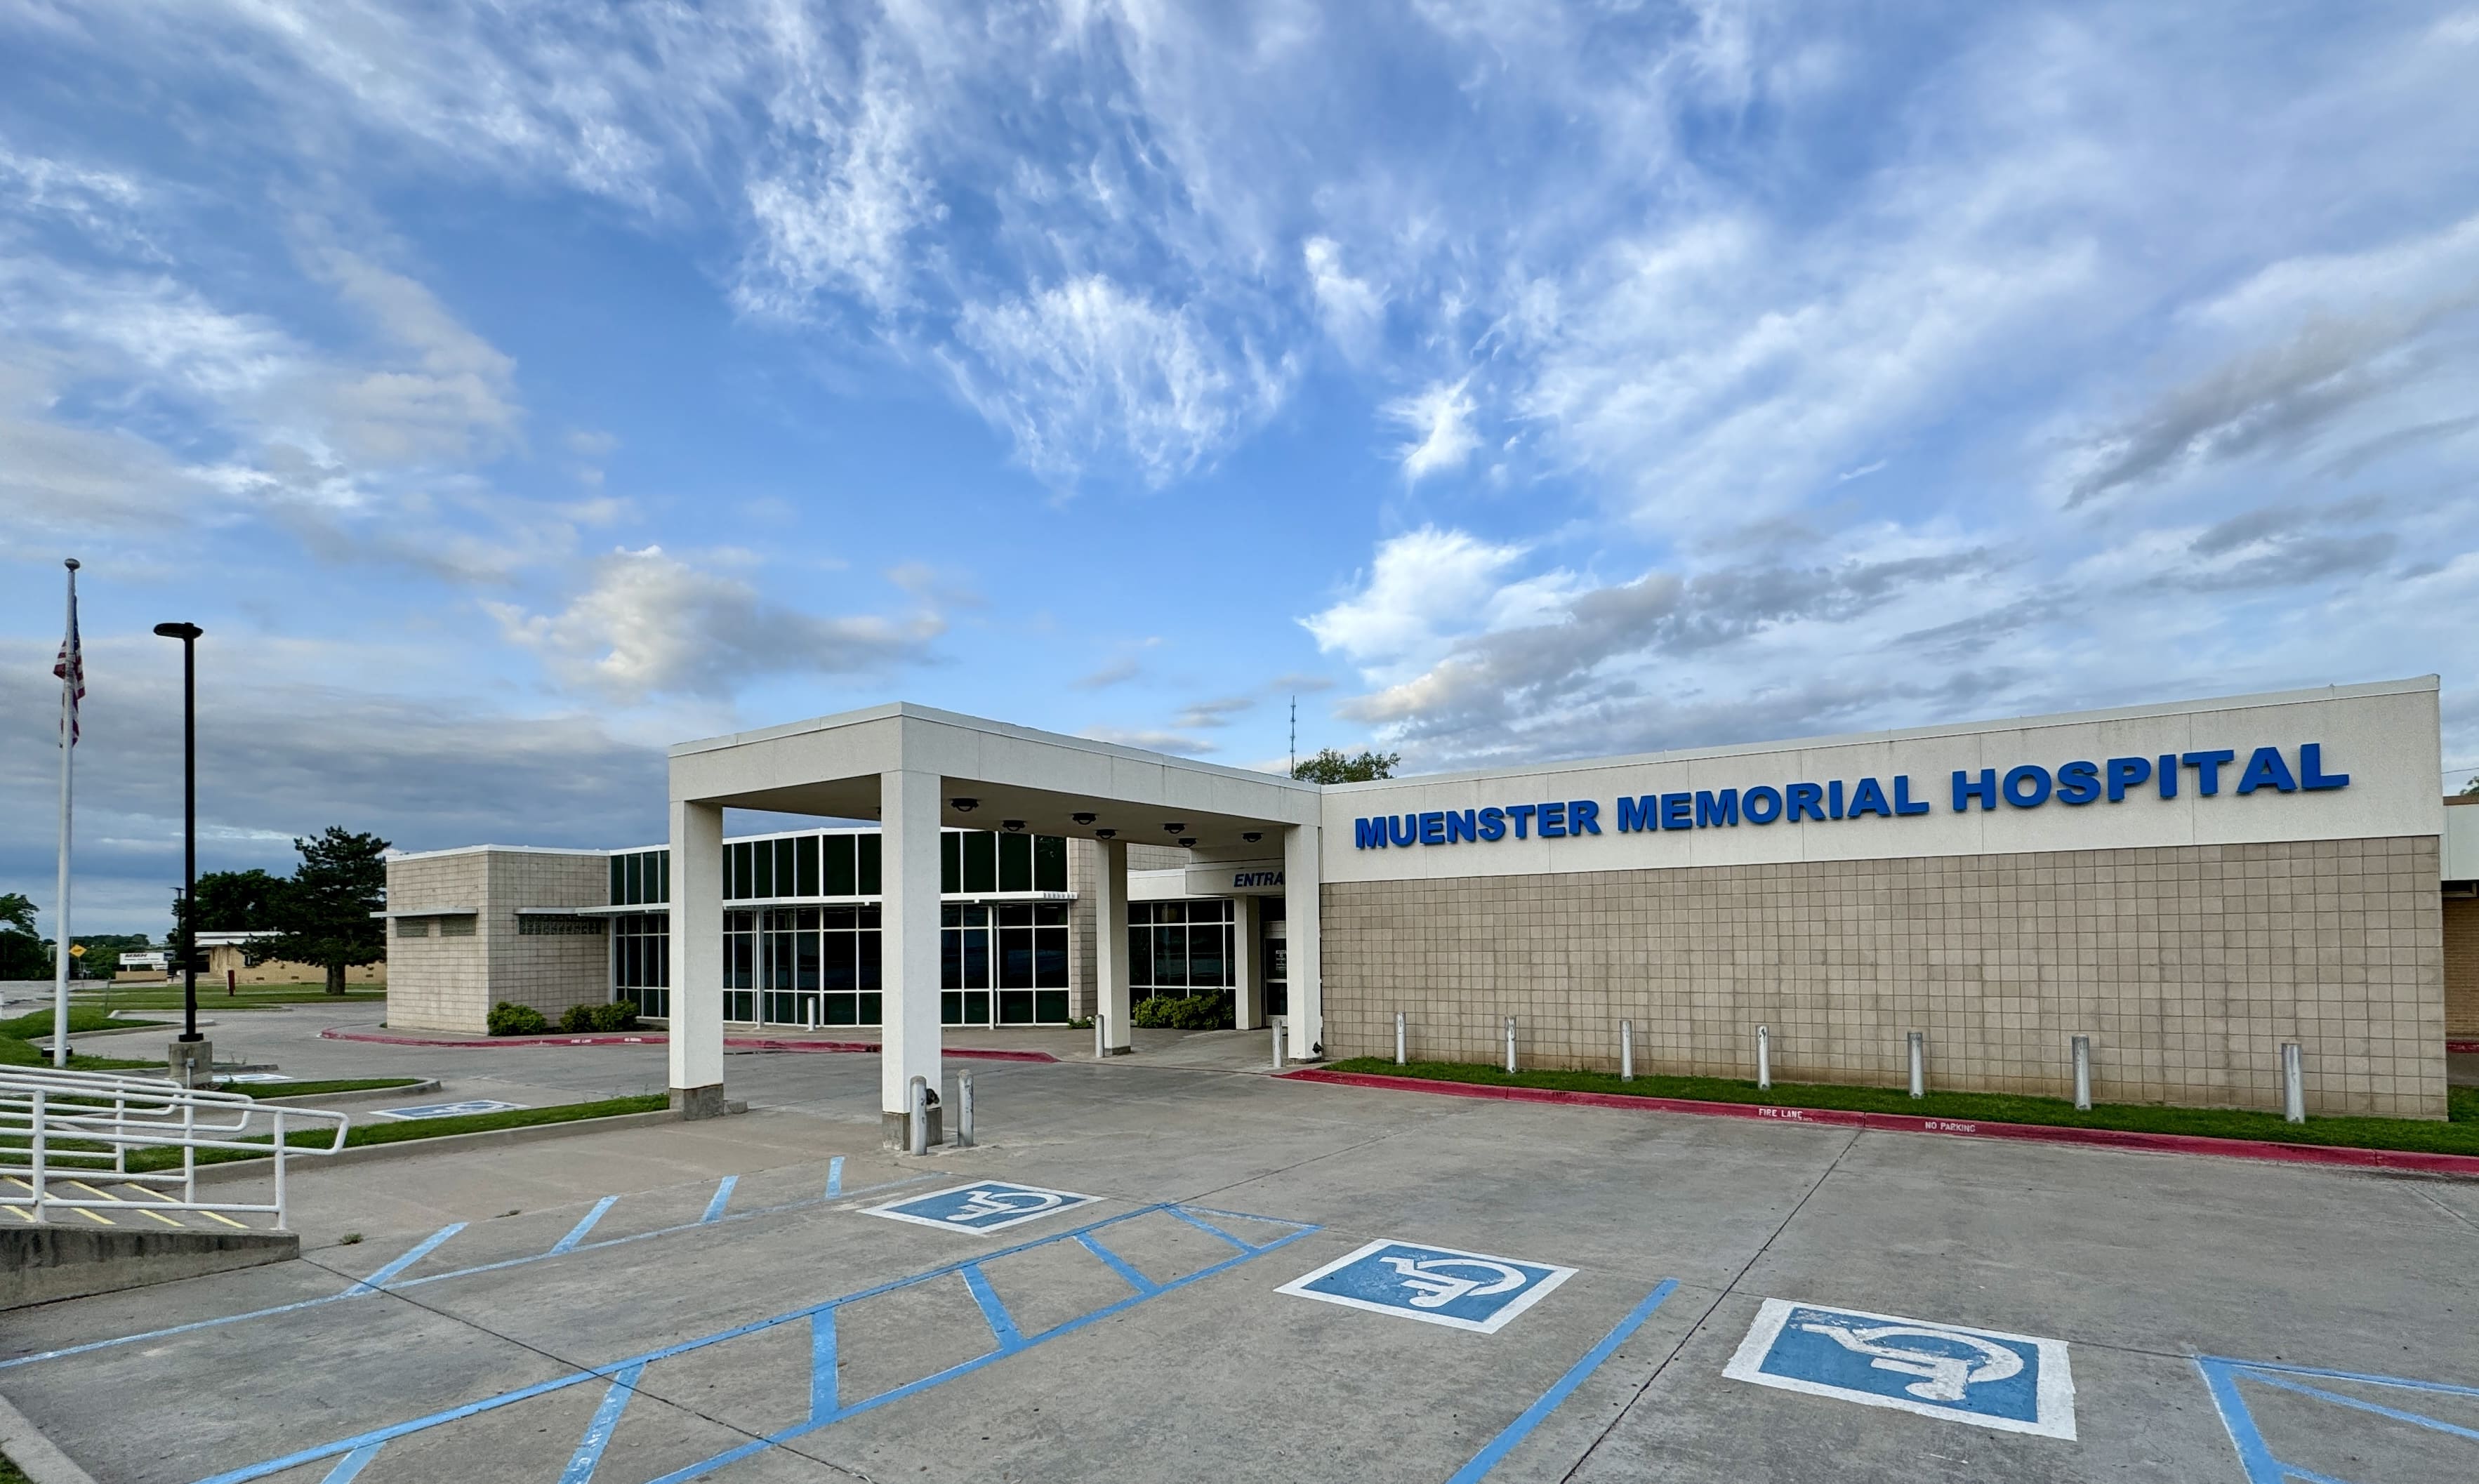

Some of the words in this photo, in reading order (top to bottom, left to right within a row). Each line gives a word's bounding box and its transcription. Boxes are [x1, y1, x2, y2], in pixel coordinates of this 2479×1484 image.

[1355, 800, 1601, 849] MUENSTER
[1618, 775, 1929, 832] MEMORIAL
[1952, 743, 2349, 811] HOSPITAL
[1759, 1108, 1778, 1117] FIRE
[1781, 1110, 1803, 1118] LANE
[1925, 1121, 1937, 1129] NO
[1940, 1122, 1976, 1132] PARKING
